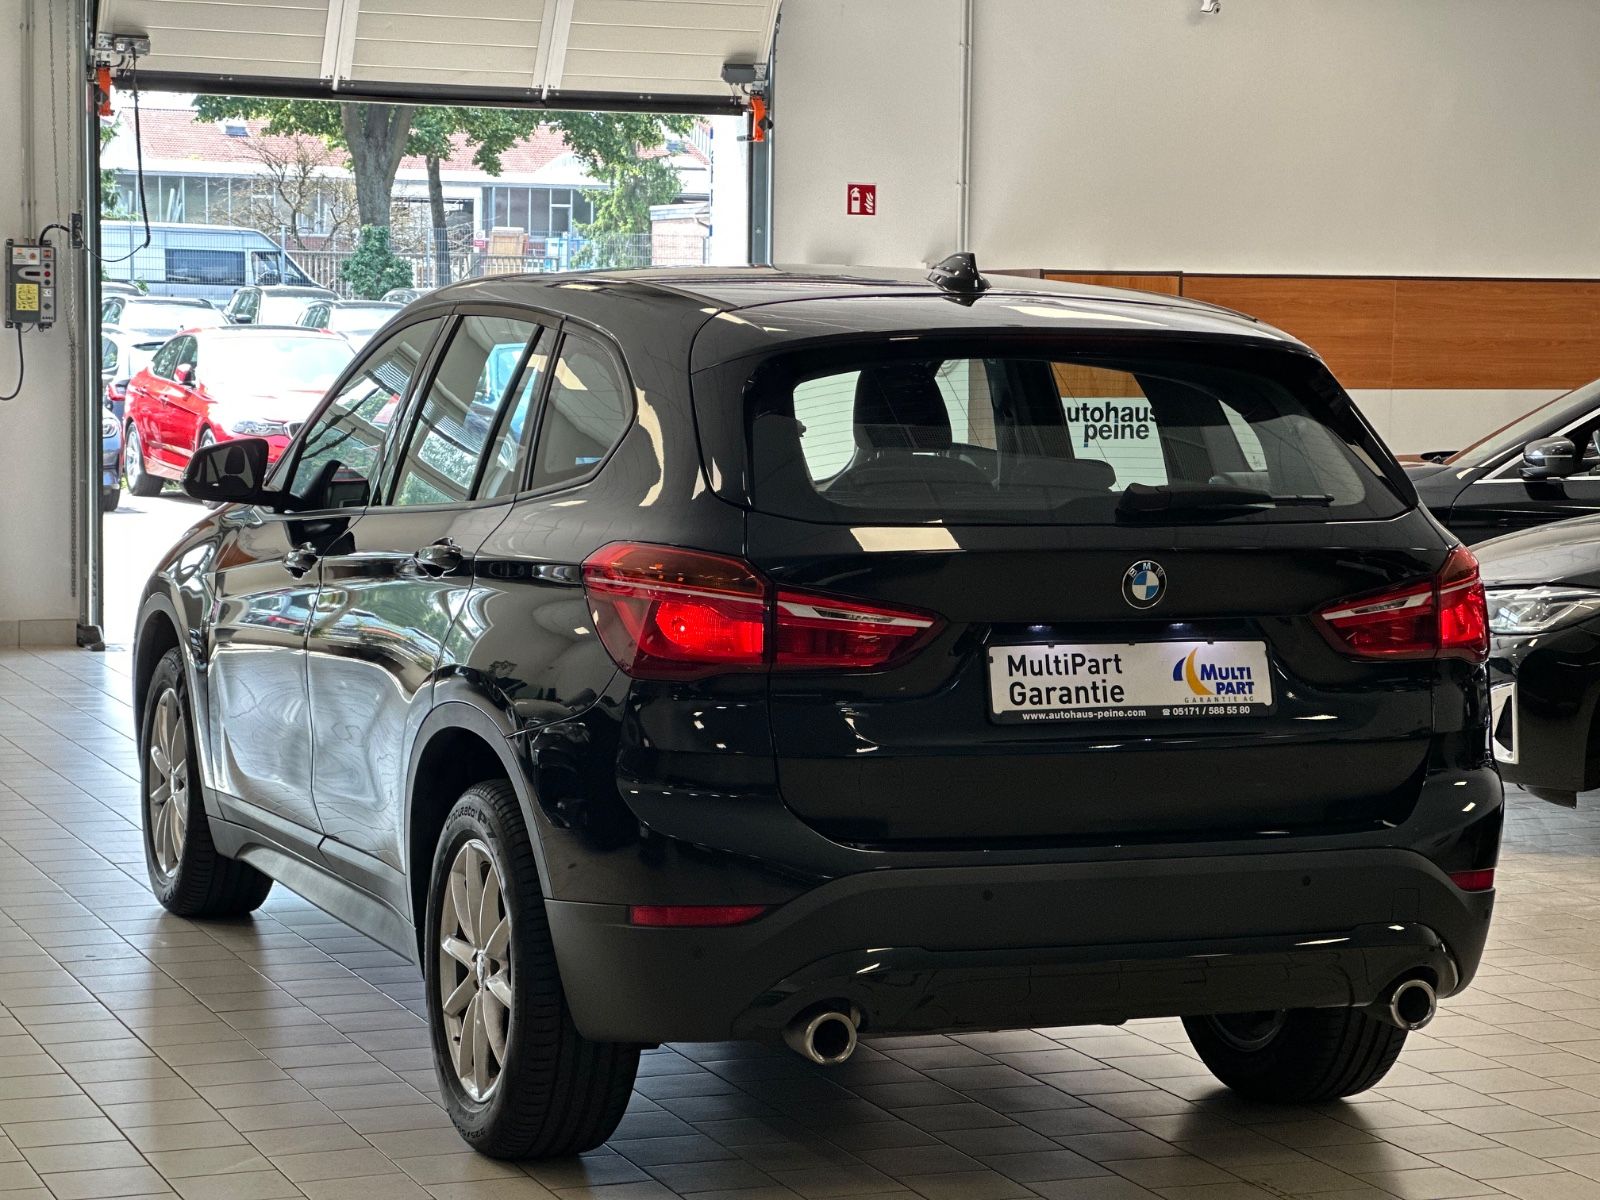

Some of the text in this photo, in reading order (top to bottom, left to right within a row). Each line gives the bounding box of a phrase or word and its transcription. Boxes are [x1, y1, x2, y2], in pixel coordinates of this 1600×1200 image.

[1066, 401, 1156, 423] utohaus
[1083, 423, 1149, 448] peine
[1128, 562, 1164, 579] BMW
[1007, 653, 1123, 677] MultiPart
[1009, 679, 1125, 706] Garantie
[1215, 681, 1255, 695] PART
[1184, 696, 1241, 704] GARANTIE
[1022, 708, 1147, 720] www.autohaus-peine.com
[1172, 706, 1200, 716] 05171
[1208, 706, 1225, 716] 588
[1226, 706, 1238, 715] 55
[1239, 706, 1251, 715] 80
